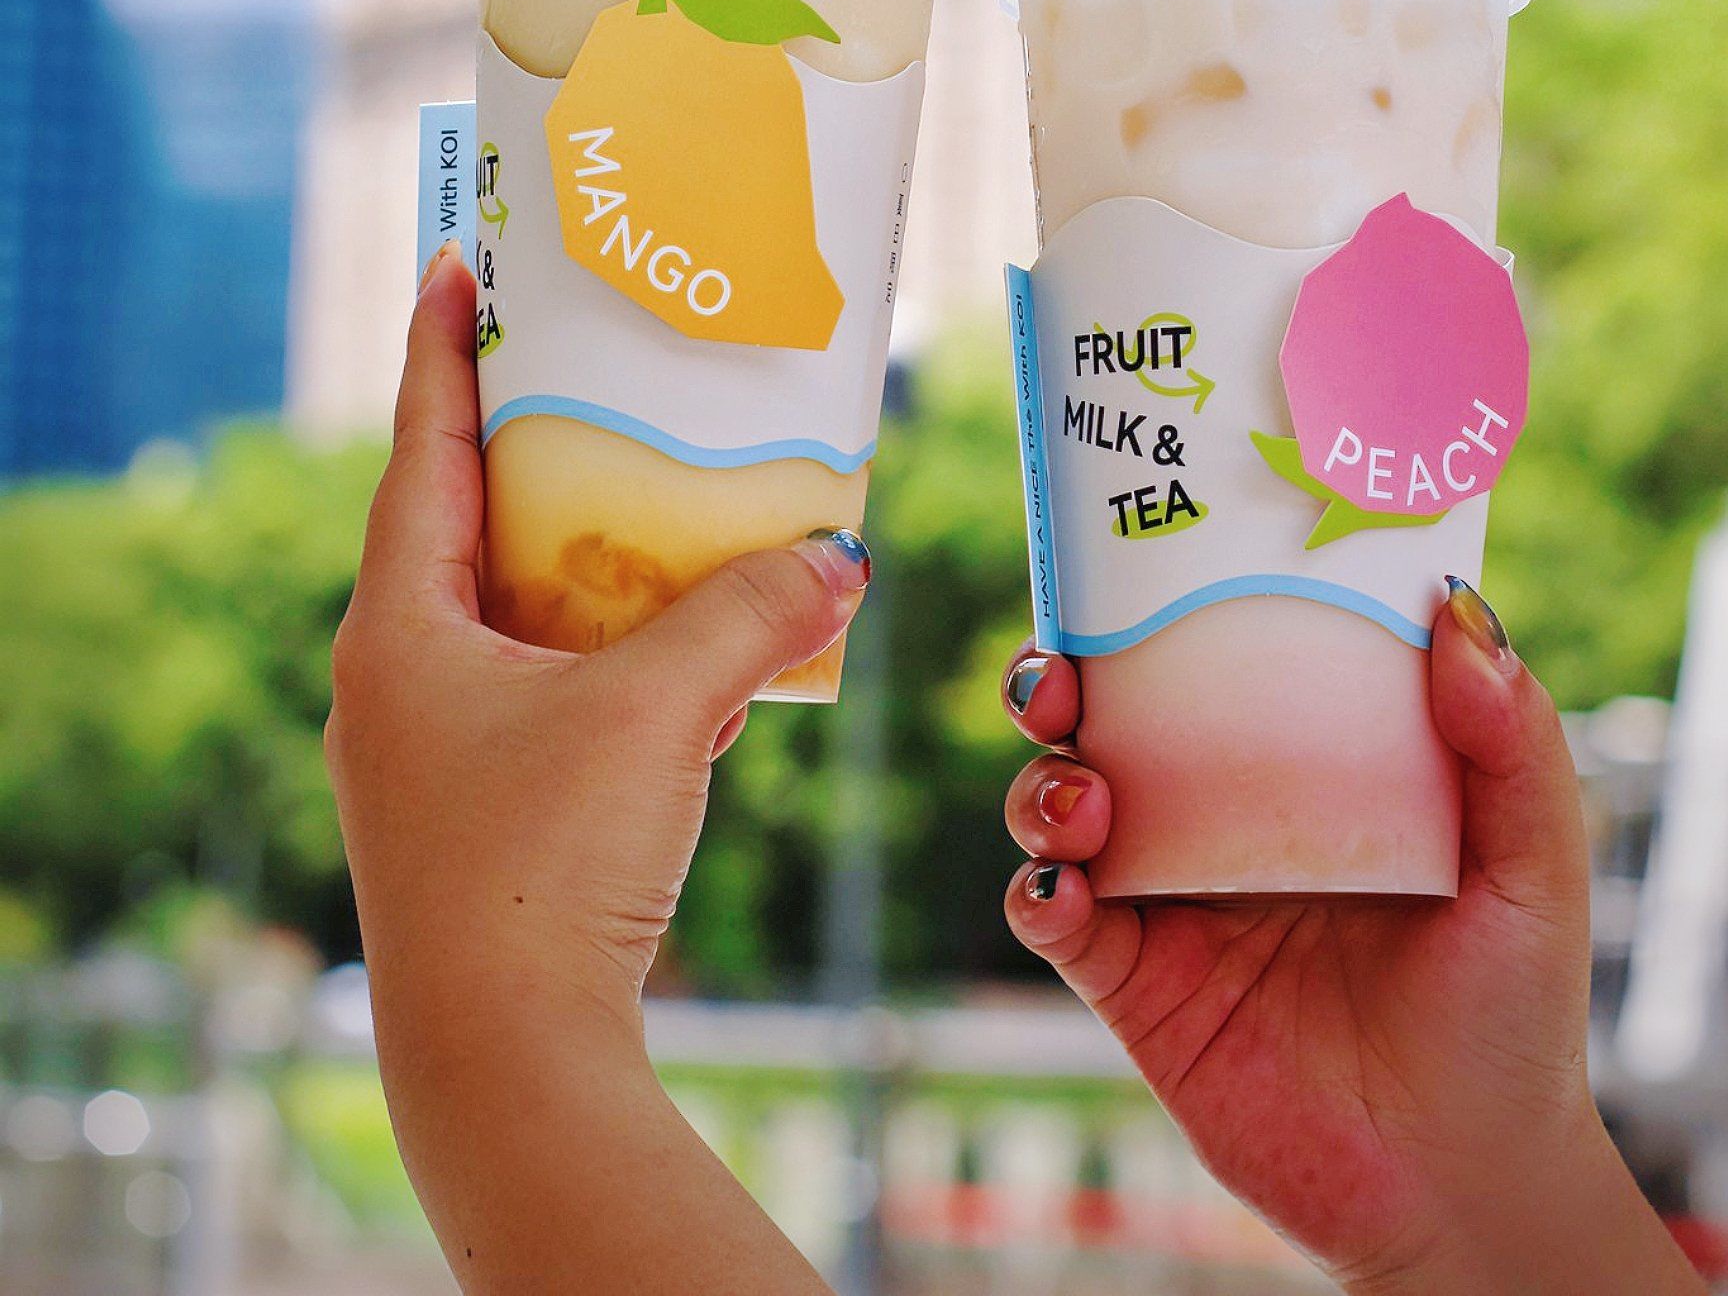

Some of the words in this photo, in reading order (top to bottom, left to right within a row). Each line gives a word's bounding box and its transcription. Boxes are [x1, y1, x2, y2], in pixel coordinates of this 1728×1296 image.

[440, 129, 458, 169] KOI
[440, 178, 457, 232] With
[568, 127, 731, 316] MANGO
[483, 250, 496, 291] &
[1015, 294, 1026, 337] KOI
[1019, 344, 1031, 401] With
[1074, 326, 1192, 377] FRUIT
[1063, 394, 1148, 458] MILK
[1152, 424, 1186, 467] &
[1323, 398, 1510, 507] PEACH
[1030, 461, 1042, 519] NICE
[1108, 479, 1200, 537] TEA
[1036, 527, 1044, 545] A
[1038, 549, 1050, 618] HAVE
